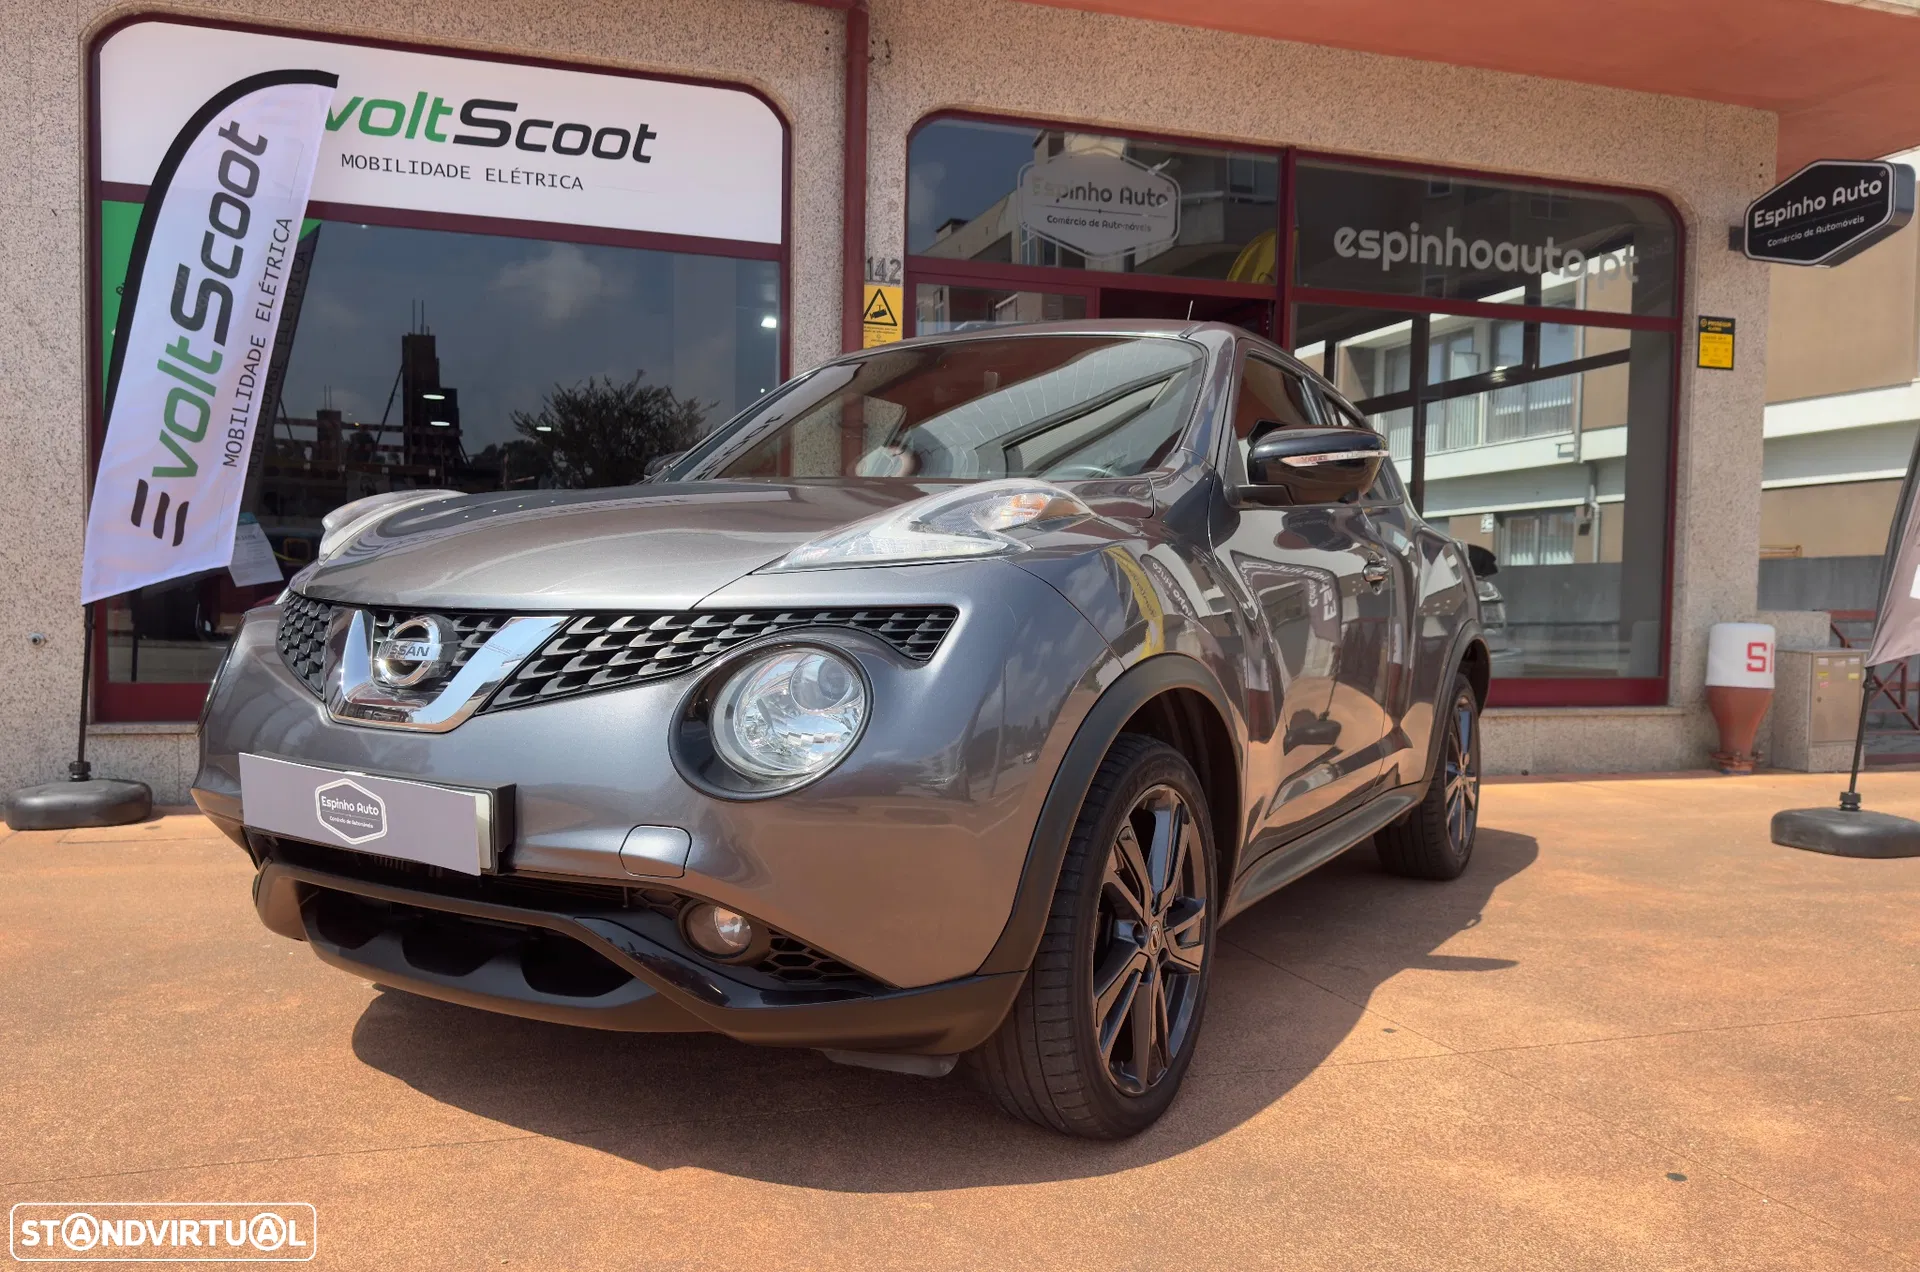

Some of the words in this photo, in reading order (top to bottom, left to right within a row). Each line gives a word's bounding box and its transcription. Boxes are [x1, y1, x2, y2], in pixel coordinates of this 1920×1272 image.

[340, 153, 472, 180] MOBILIDADE
[485, 167, 584, 190] ELÉTRICA
[1119, 186, 1169, 208] Auto
[1754, 194, 1826, 229] Espinho
[1832, 178, 1883, 207] Auto
[1046, 214, 1087, 227] Comércio
[1089, 219, 1100, 228] de
[1767, 231, 1803, 248] Comércio
[1804, 228, 1814, 238] de
[1815, 214, 1865, 234] Automóveis
[866, 256, 902, 284] 142
[1333, 221, 1640, 291] espinhoauto.pt
[222, 335, 266, 468] MOBILIDADE
[255, 217, 293, 323] ELÉTRICA
[321, 795, 355, 812] Espinho
[356, 802, 379, 816] Auto
